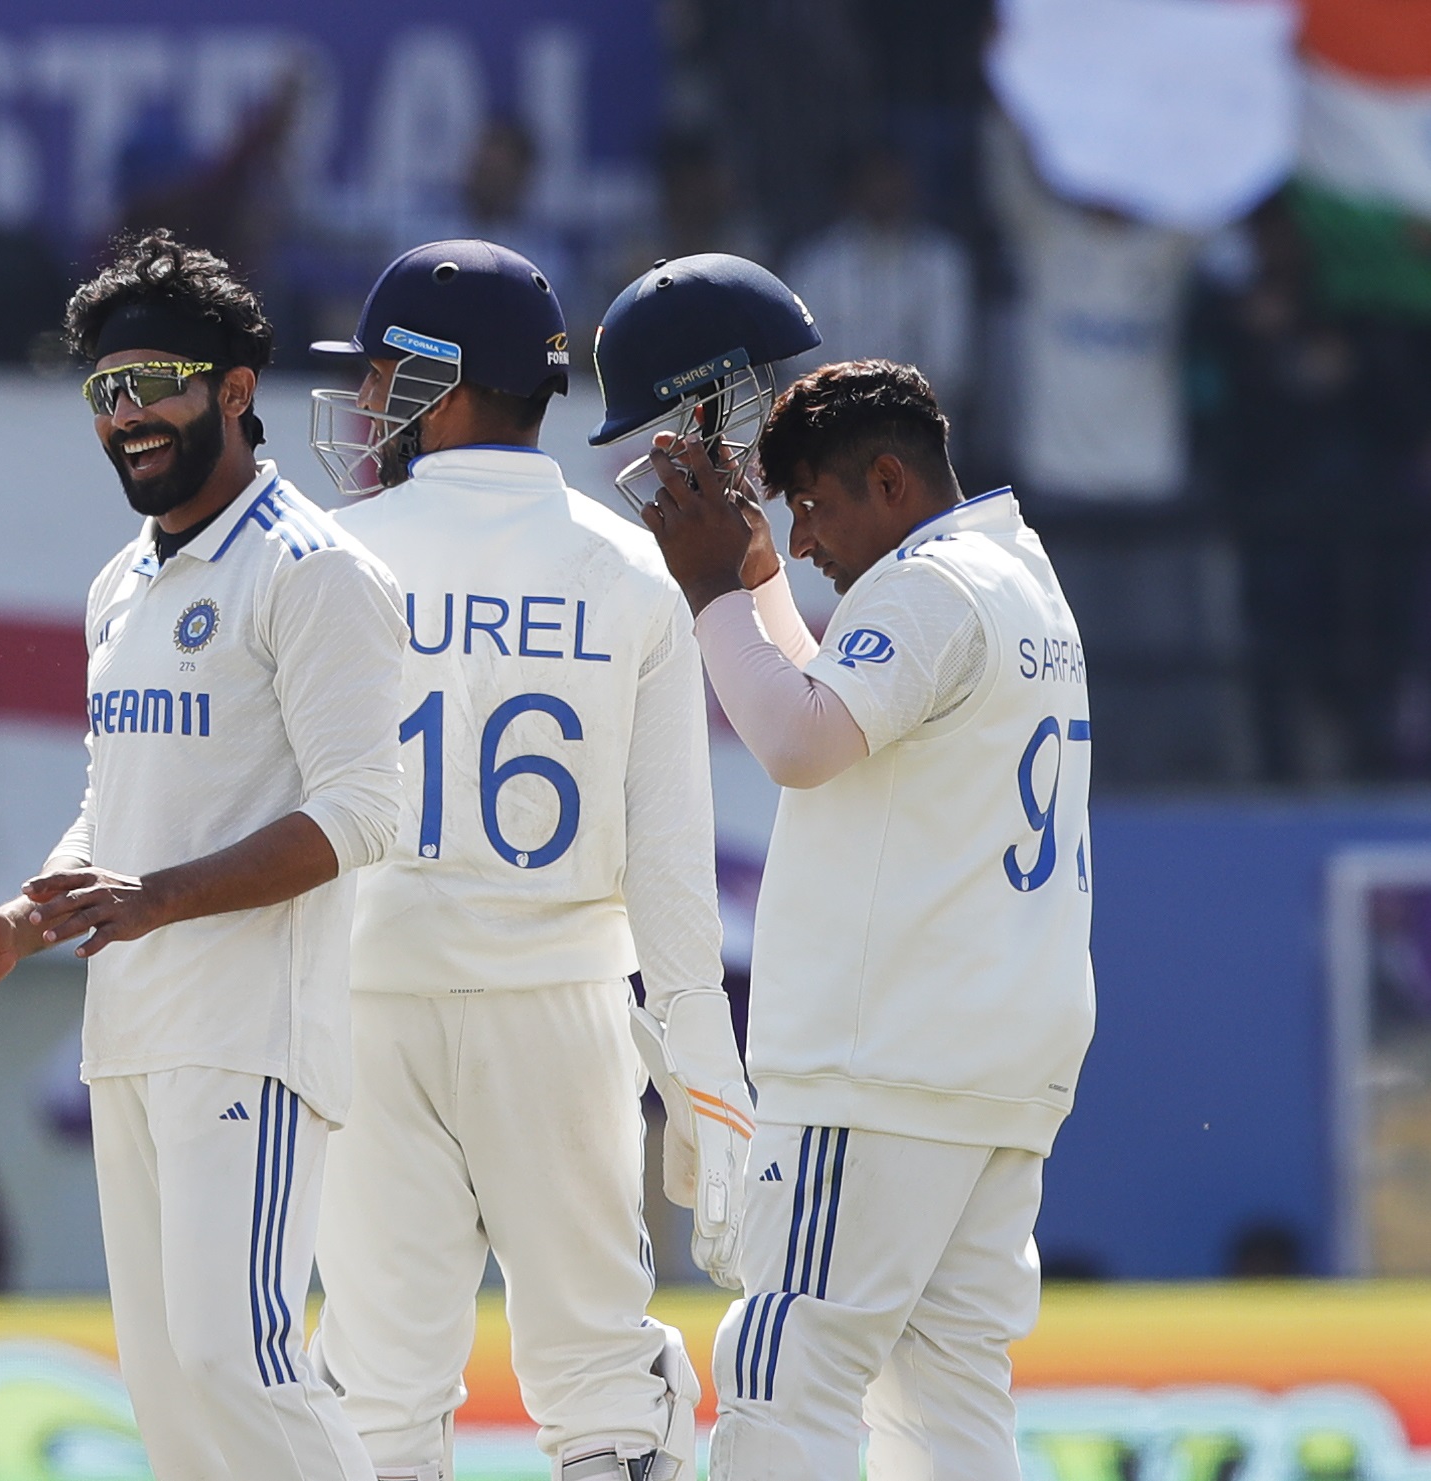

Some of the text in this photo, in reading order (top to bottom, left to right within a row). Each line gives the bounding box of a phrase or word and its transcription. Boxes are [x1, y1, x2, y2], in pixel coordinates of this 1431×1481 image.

[407, 338, 440, 354] FORMA
[672, 362, 716, 389] SHREY
[406, 592, 612, 663] UREL
[179, 661, 196, 672] 275
[87, 688, 210, 737] REAM11
[399, 690, 584, 869] 16
